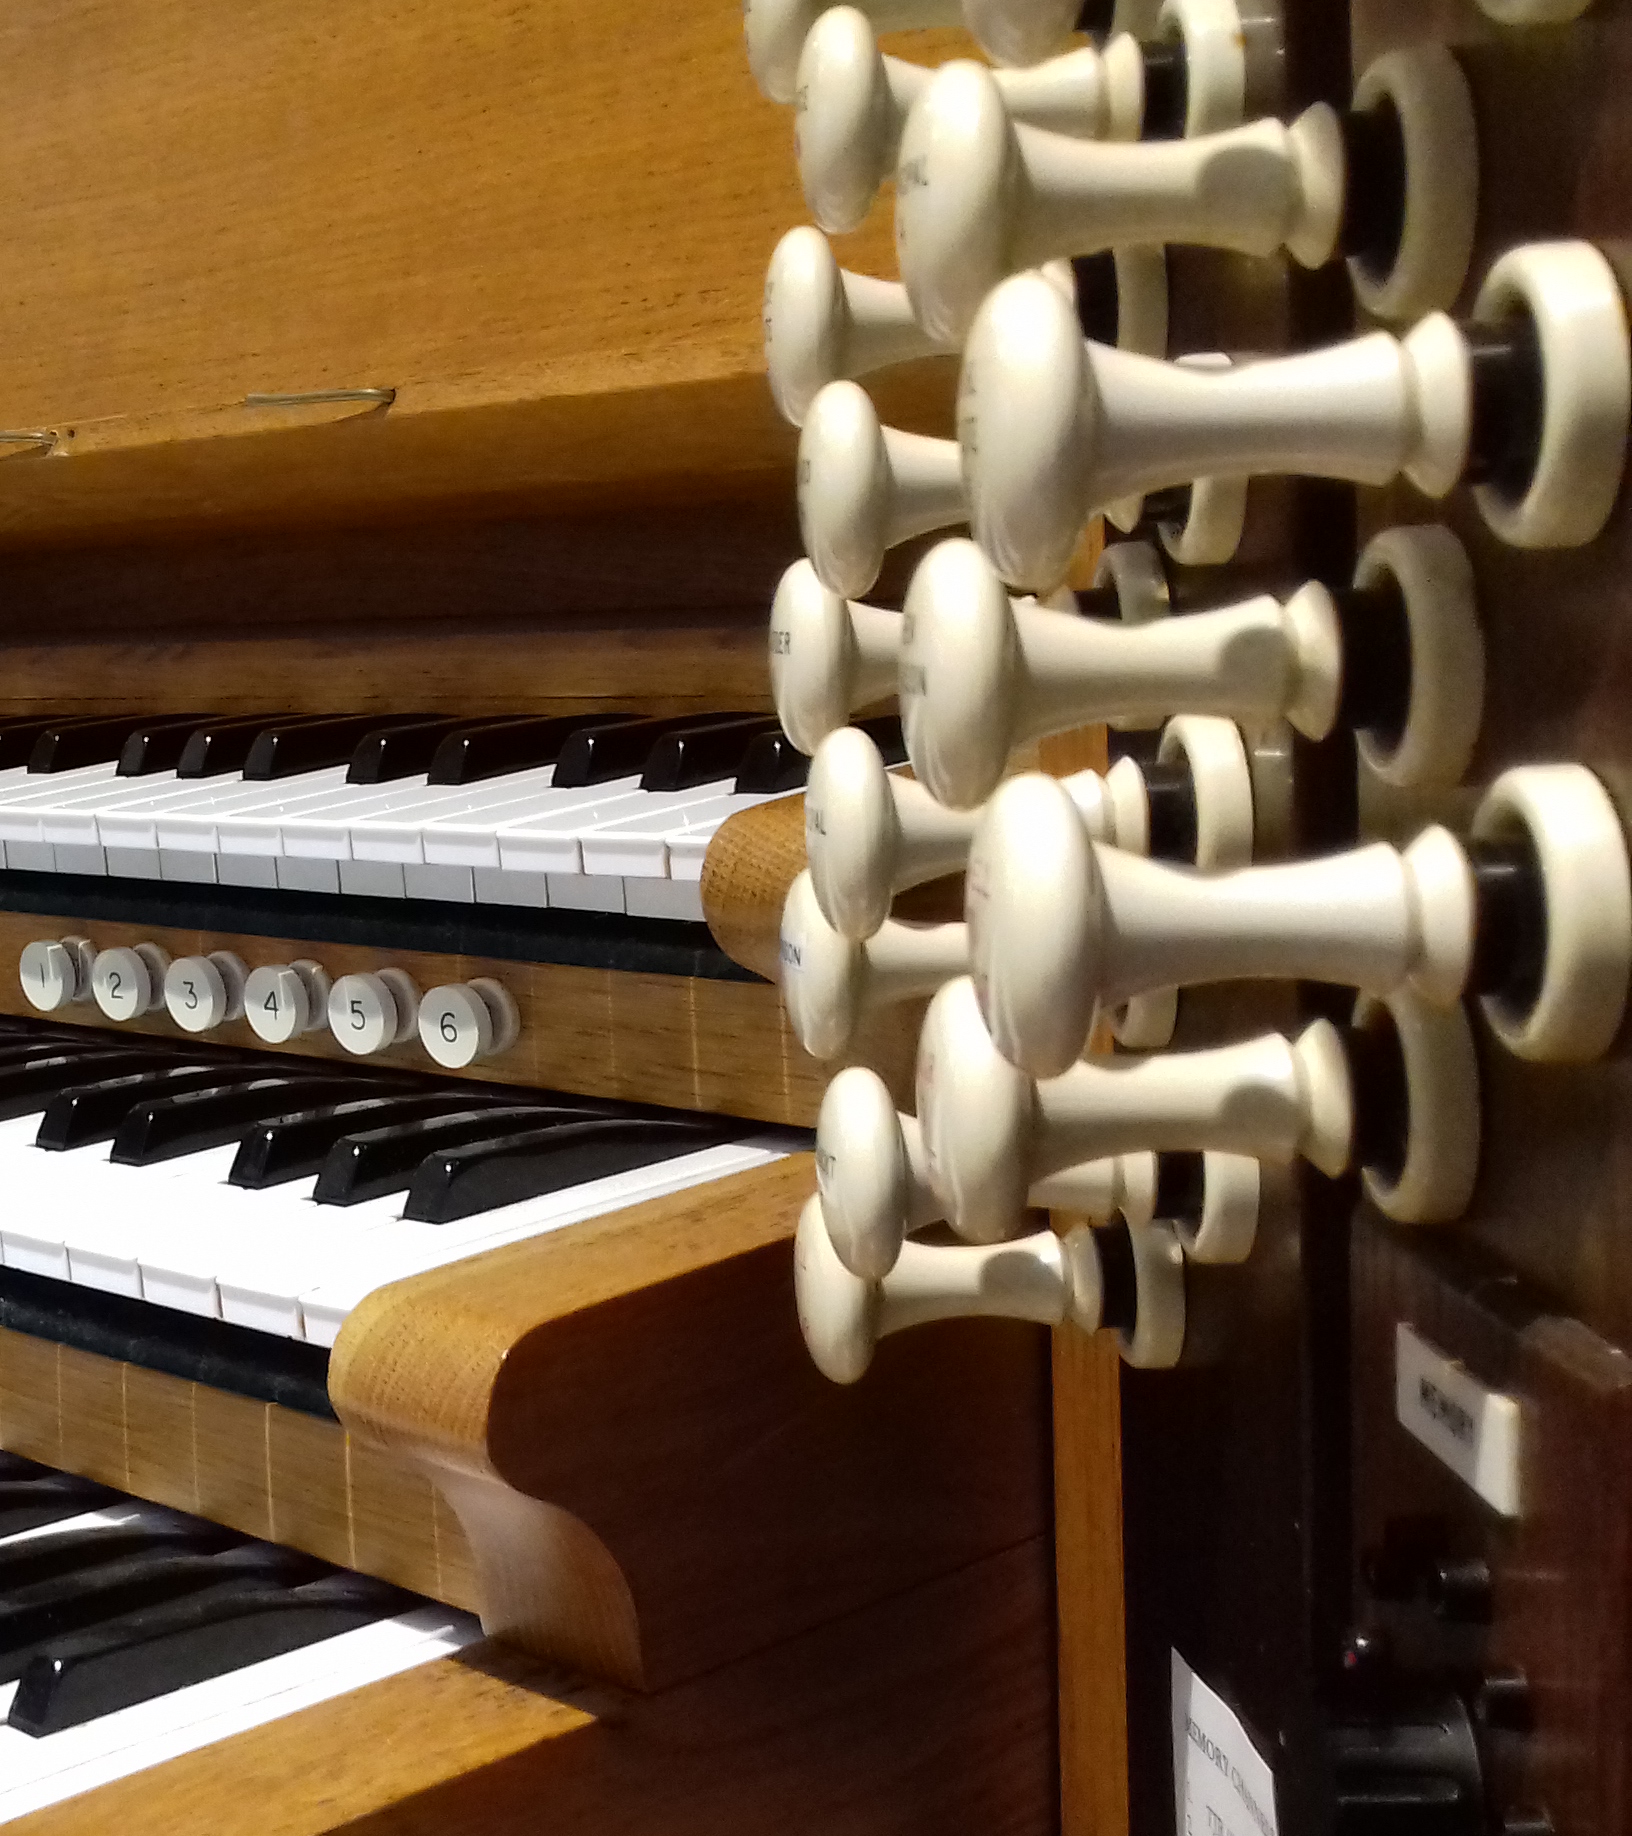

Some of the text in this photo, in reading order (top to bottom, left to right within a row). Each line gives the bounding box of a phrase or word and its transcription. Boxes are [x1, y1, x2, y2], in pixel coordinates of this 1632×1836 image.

[109, 972, 124, 999] 2
[183, 981, 198, 1010] 3
[263, 990, 279, 1021] 4
[350, 1000, 366, 1031] 5
[440, 1012, 458, 1043] 6
